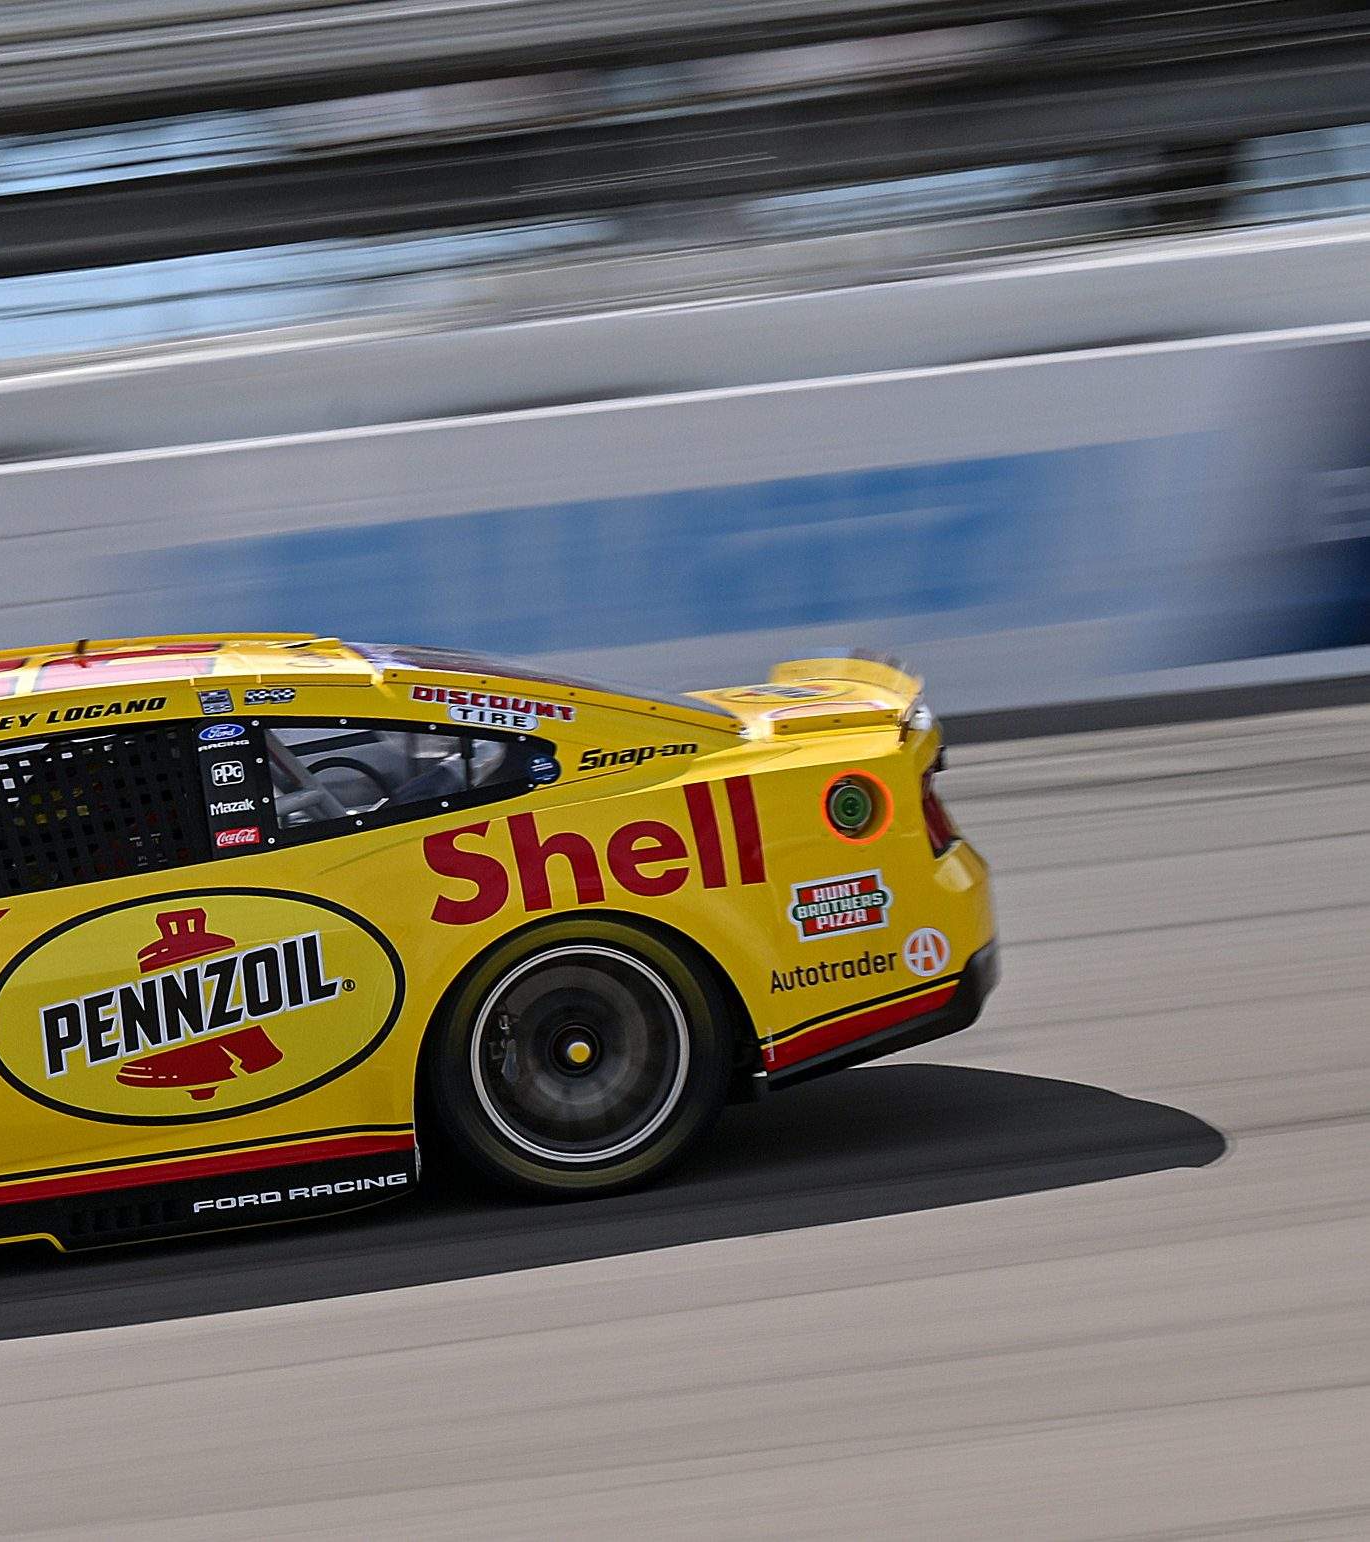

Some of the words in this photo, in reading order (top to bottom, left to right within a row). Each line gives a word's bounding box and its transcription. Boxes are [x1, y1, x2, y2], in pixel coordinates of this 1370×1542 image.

[45, 697, 168, 724] LOGANO
[411, 686, 575, 721] DISCOUNT
[457, 708, 529, 728] TIRE
[197, 739, 250, 752] RACING
[207, 725, 236, 739] Ford
[577, 743, 699, 771] Snap-on
[214, 764, 243, 783] PPG
[210, 798, 255, 816] Mazak
[422, 775, 767, 926] Shell
[812, 881, 862, 902] HUNT
[796, 892, 884, 919] BROTHERS
[816, 908, 868, 930] PIZZA
[770, 951, 897, 994] Autotrader
[39, 930, 343, 1079] PENNZOIL
[193, 1191, 282, 1213] FORD
[288, 1172, 408, 1200] RACING
